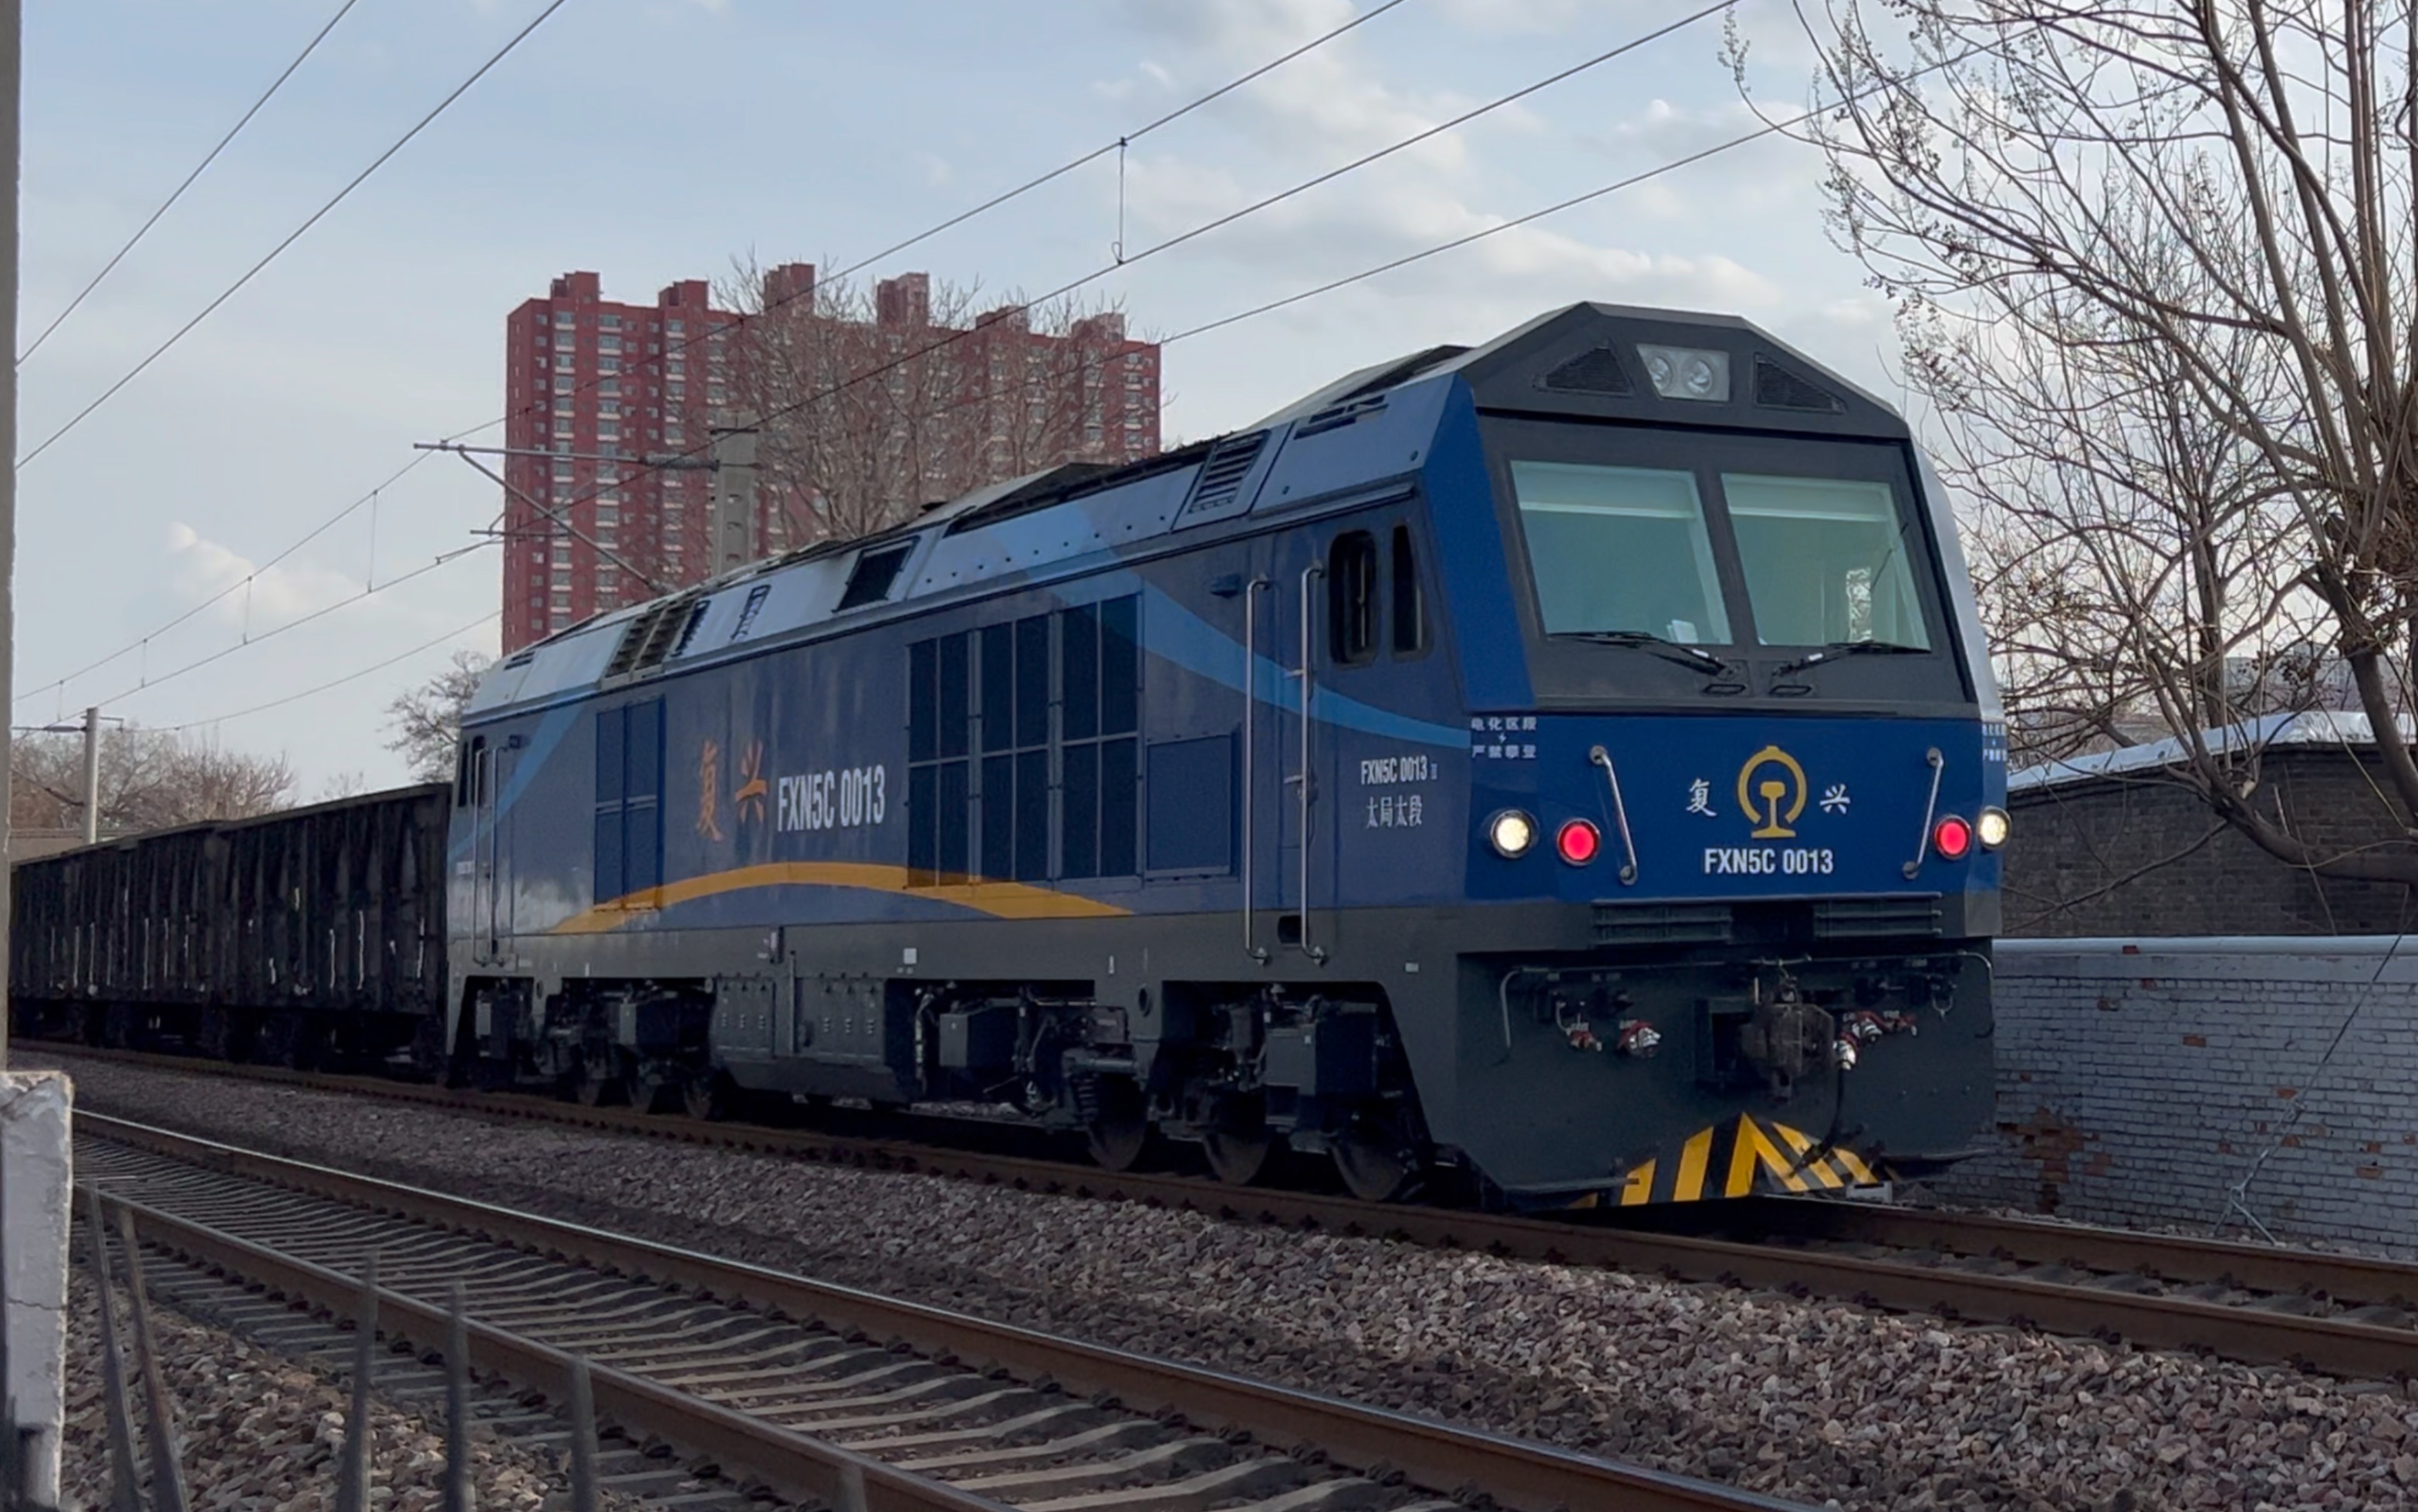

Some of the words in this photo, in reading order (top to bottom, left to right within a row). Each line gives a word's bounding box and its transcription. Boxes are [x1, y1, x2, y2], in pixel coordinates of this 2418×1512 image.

[1361, 758, 1397, 785] FXN5C
[1400, 755, 1427, 781] 0013
[777, 771, 835, 832] FXN5C
[840, 764, 885, 827] 0013
[1687, 778, 1716, 816] 复
[1819, 784, 1850, 814] 兴
[1704, 849, 1775, 873] FXN5C
[1782, 849, 1833, 873] 0013
